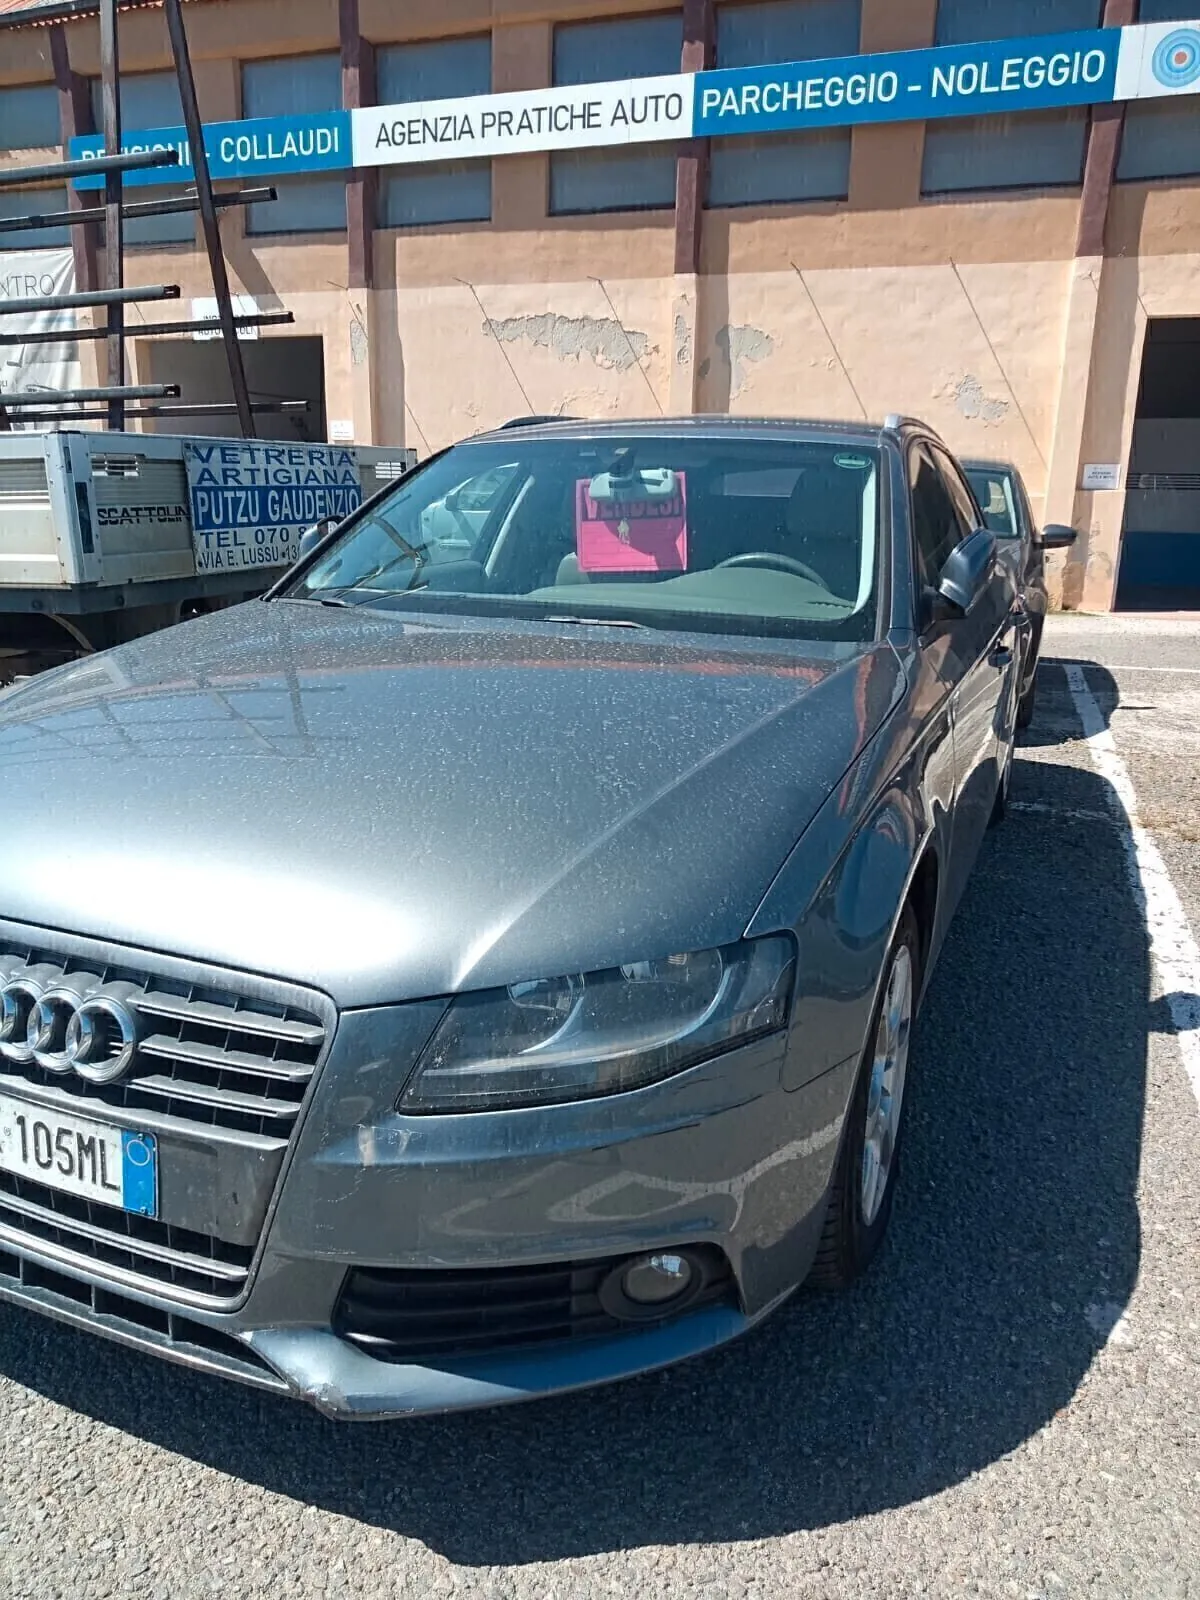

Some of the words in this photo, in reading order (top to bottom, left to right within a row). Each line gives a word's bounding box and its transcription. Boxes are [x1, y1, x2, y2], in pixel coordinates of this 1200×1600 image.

[702, 70, 897, 119] PARCHEGGIO
[907, 84, 922, 92] -
[931, 48, 1106, 98] NOLEGGIO
[375, 114, 475, 148] AGENZIA
[481, 101, 602, 138] PRATICHE
[610, 92, 683, 127] AUTO
[220, 127, 339, 163] COLLAUDI
[192, 446, 354, 466] VETRERIA
[196, 467, 357, 485] ARTIGIANA
[196, 490, 260, 525] PUTZU
[267, 488, 360, 522] GAUDENZIO
[200, 530, 246, 549] TEL
[254, 527, 290, 545] 070
[201, 552, 224, 569] VIA
[227, 549, 238, 567] E.
[242, 545, 279, 564] LUSSU
[16, 1115, 121, 1192] 105ML
